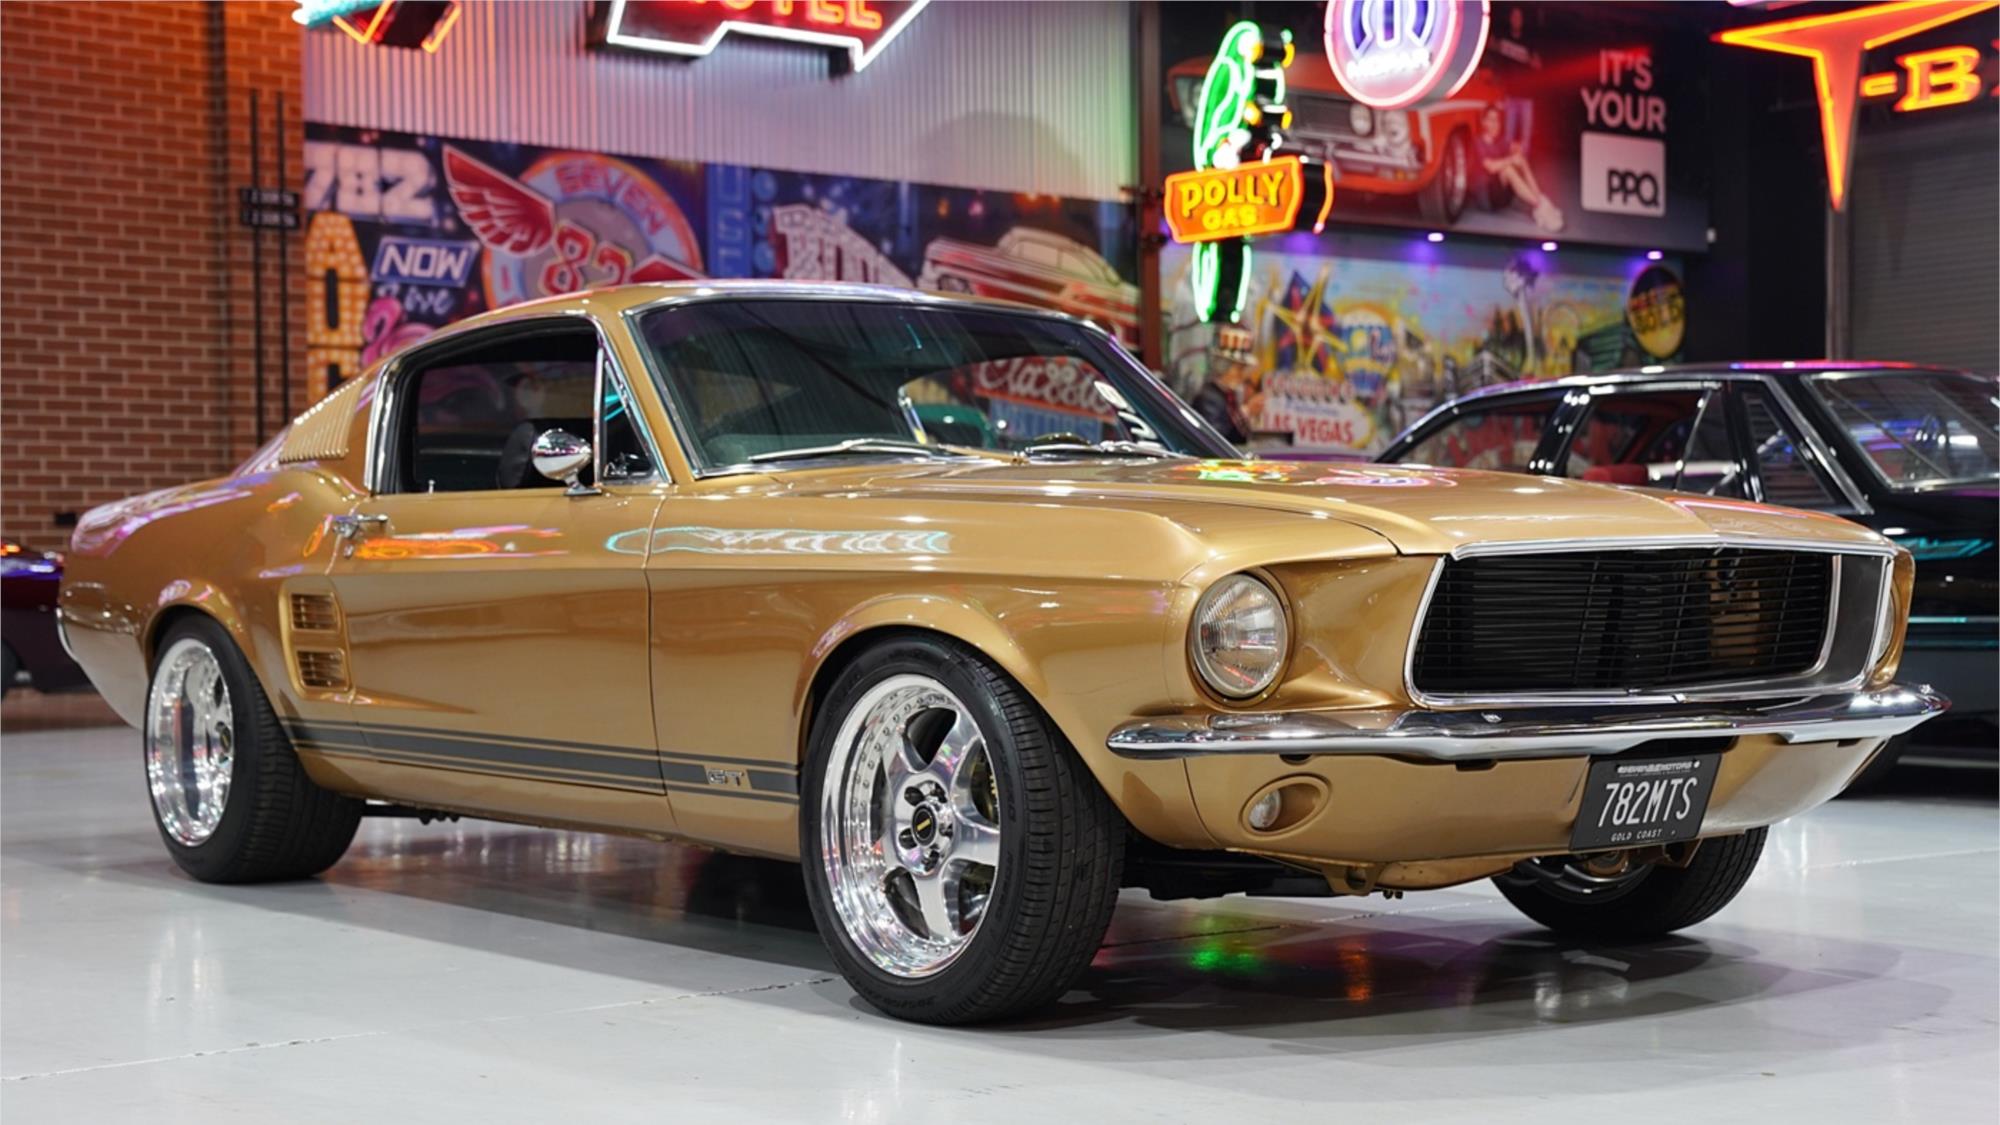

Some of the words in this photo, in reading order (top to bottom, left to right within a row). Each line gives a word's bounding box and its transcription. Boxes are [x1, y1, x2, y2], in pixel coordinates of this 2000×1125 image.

[1600, 49, 1654, 90] IT'S
[1580, 87, 1666, 132] YOUR
[303, 143, 436, 221] 782
[554, 161, 667, 235] SEVEN
[1180, 171, 1285, 218] POLLY
[1607, 168, 1660, 208] PPQ
[1203, 204, 1258, 231] GAS
[380, 245, 469, 282] NOW
[1297, 416, 1355, 445] VEGAS
[1598, 777, 1698, 828] 782MTS
[1611, 831, 1632, 842] GOLD
[1636, 829, 1662, 840] COAST
